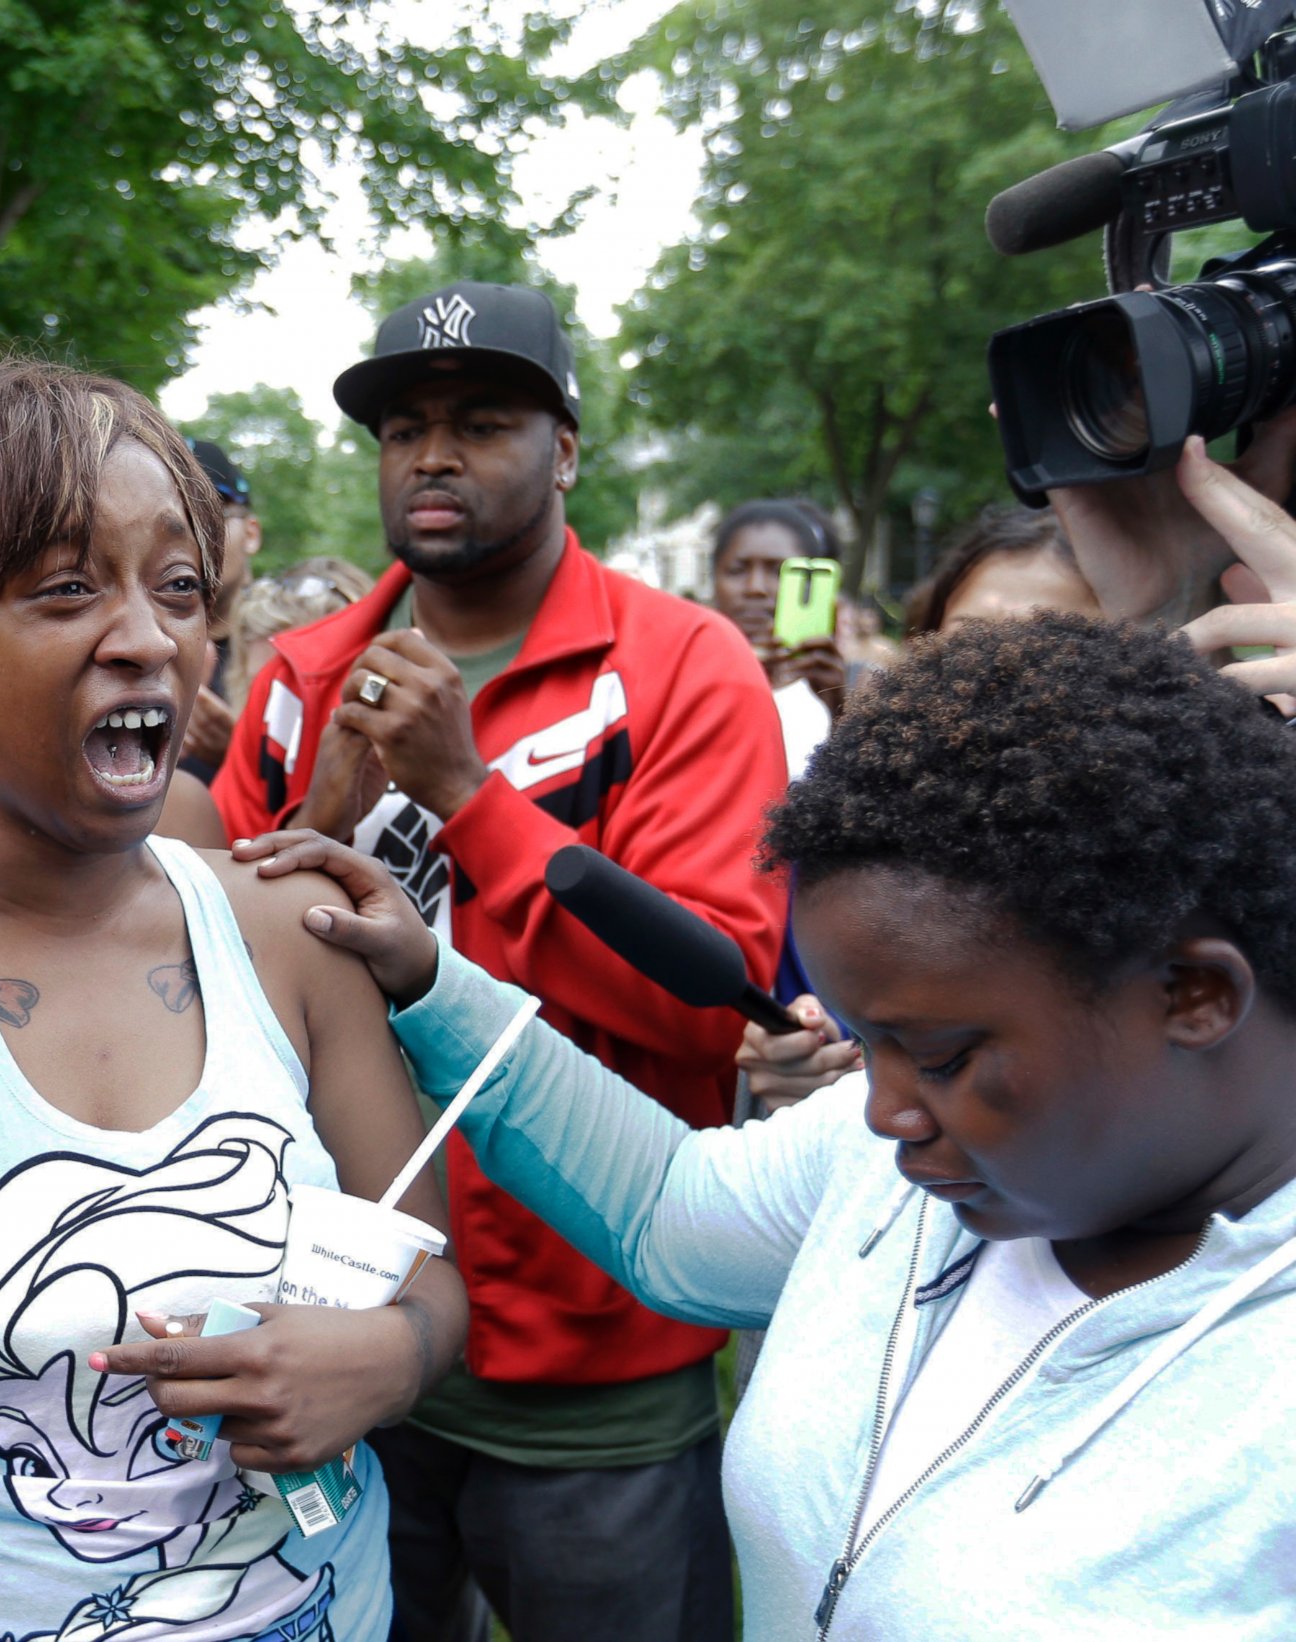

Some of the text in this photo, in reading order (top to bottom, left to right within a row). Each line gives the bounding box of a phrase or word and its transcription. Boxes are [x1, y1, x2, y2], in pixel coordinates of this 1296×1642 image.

[1180, 130, 1222, 150] SONY
[417, 294, 476, 349] NY
[311, 1243, 400, 1282] WhiteCastle.com
